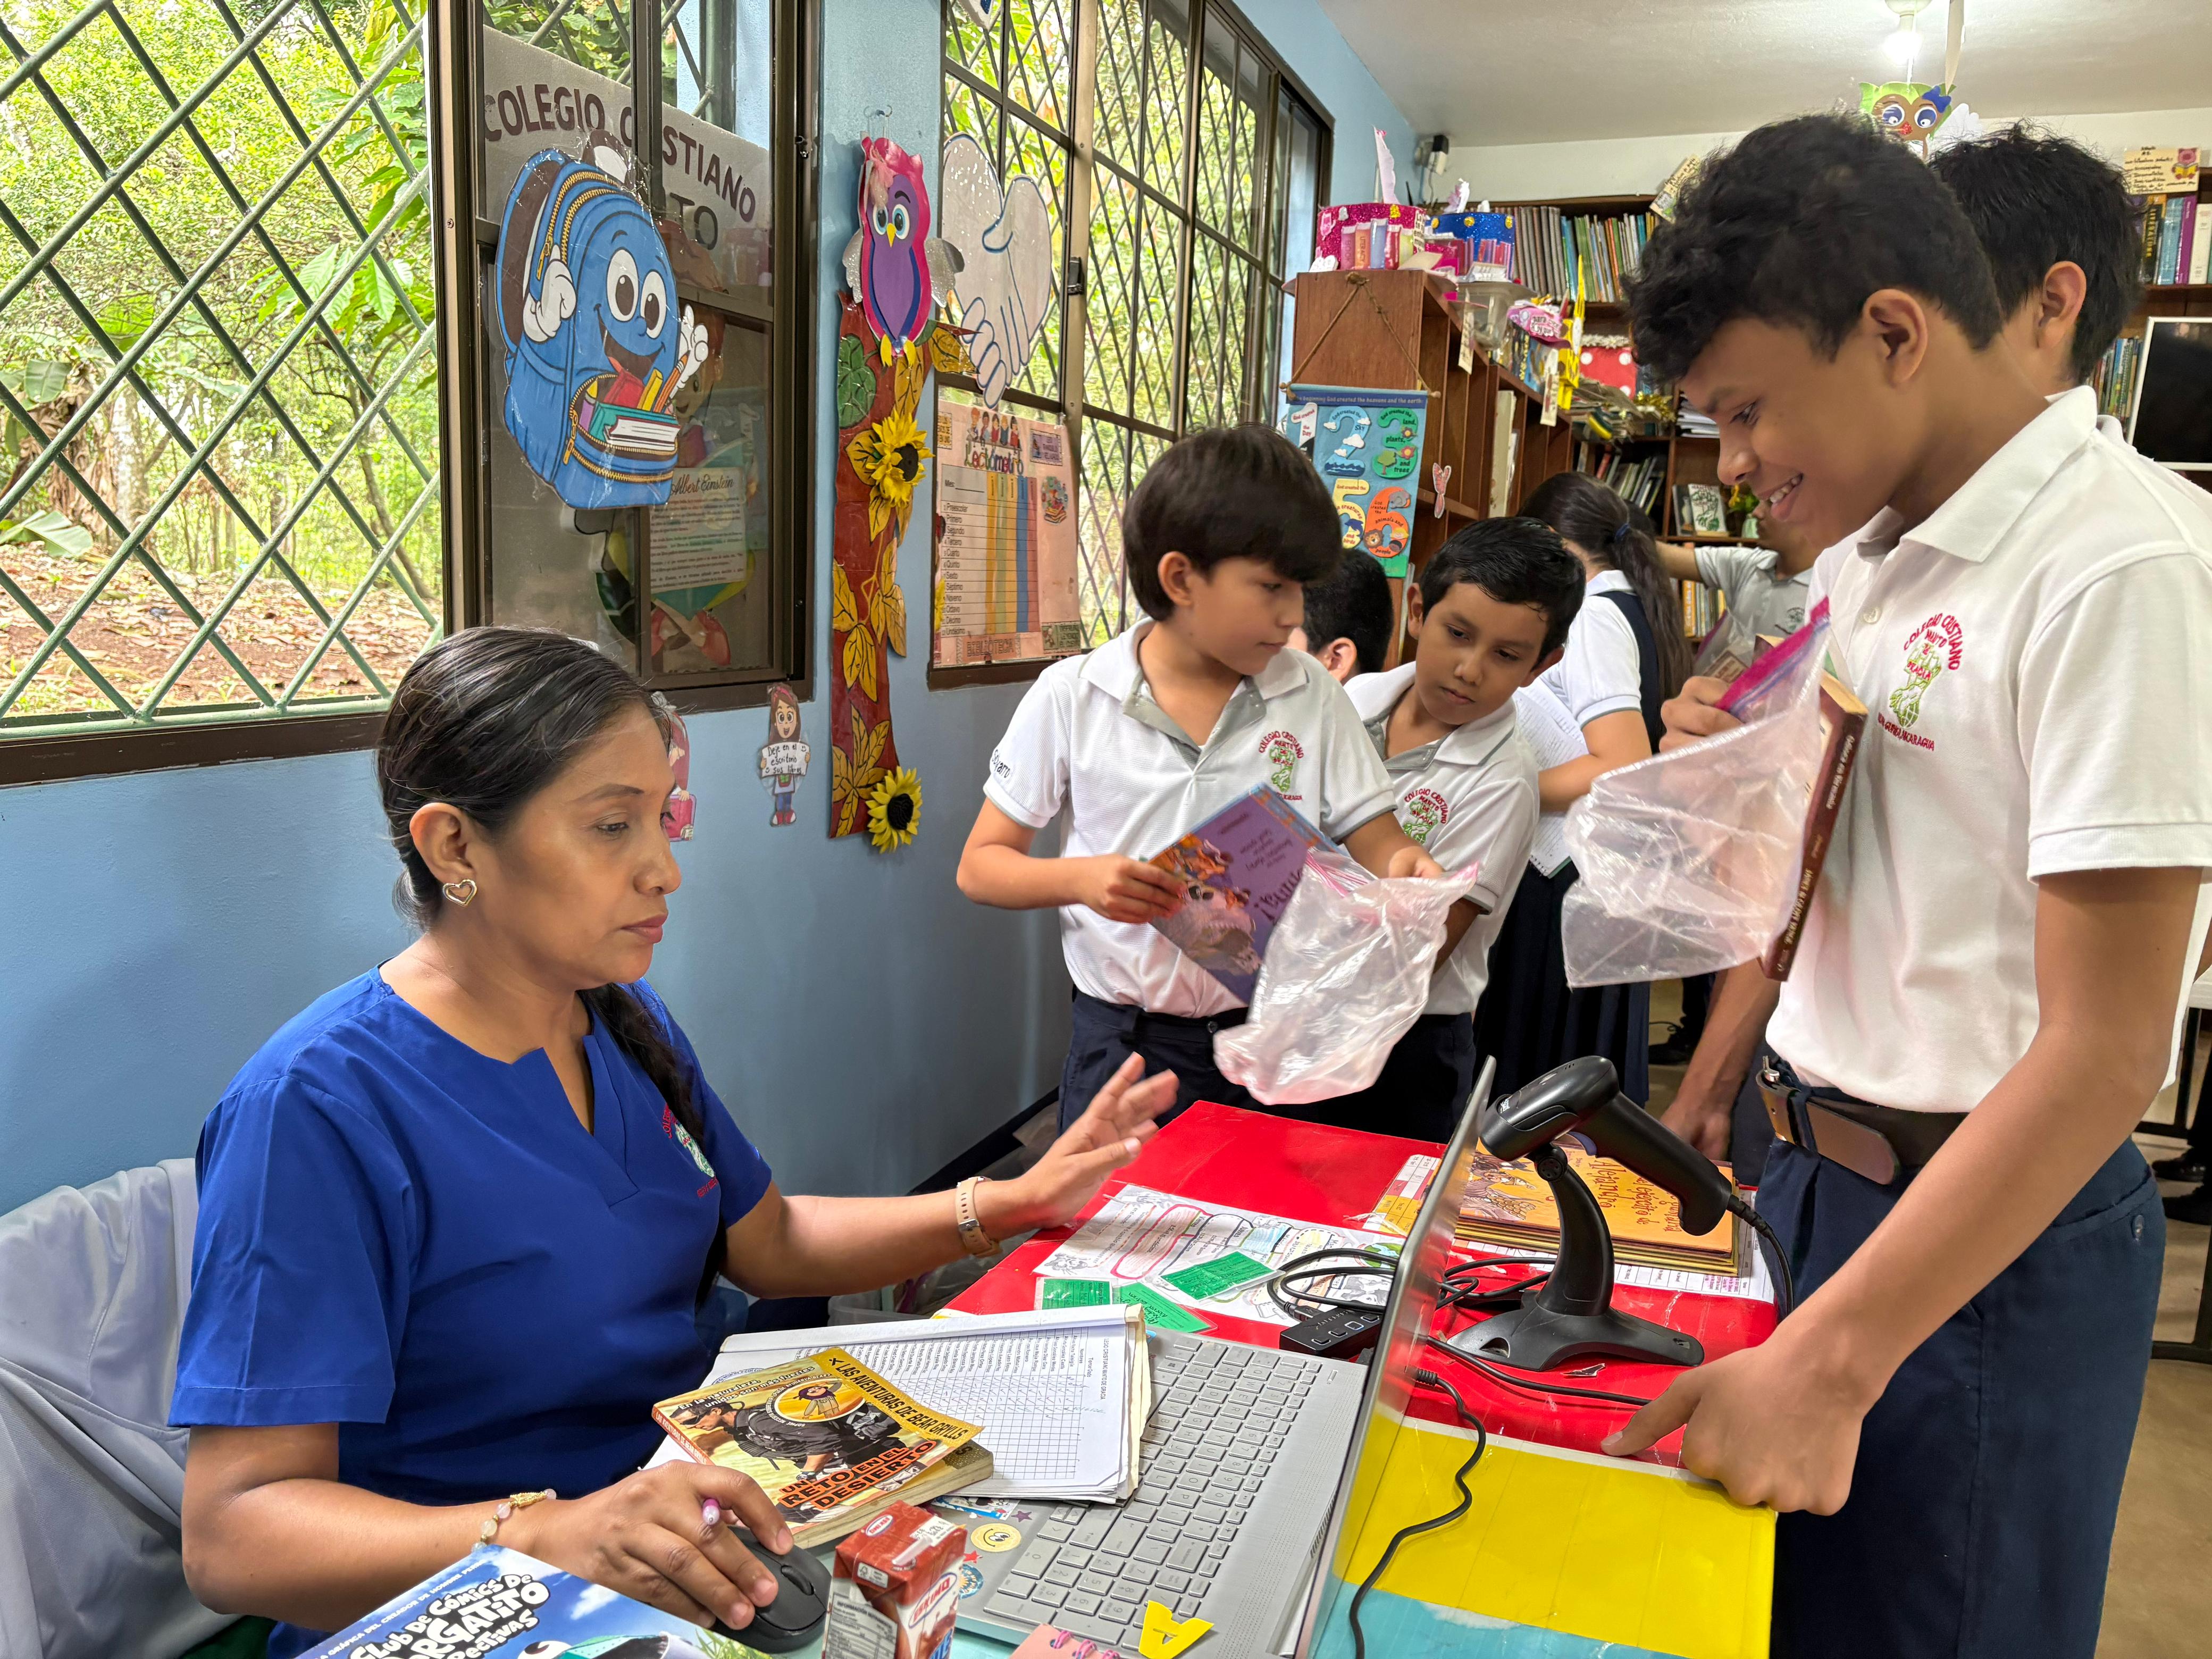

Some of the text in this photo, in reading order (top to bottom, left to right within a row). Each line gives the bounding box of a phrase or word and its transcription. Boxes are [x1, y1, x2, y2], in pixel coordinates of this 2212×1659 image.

[485, 83, 605, 142] COLEGIO
[1302, 409, 1315, 418] created
[672, 474, 734, 495] Albert Einstein
[947, 503, 968, 512] Preescolar
[948, 526, 965, 536] Segundo
[948, 537, 962, 546] Tercero
[967, 639, 1013, 657] BIBLIOTECA
[1904, 613, 1963, 671] COLEGIO CRISTIANO
[768, 745, 781, 758] Deje
[1259, 731, 1280, 753] COLEGIO
[771, 755, 797, 766] escritorio
[1404, 789, 1430, 802] COLEGIO
[1587, 1160, 1635, 1209] Alejandro
[705, 1366, 815, 1407] unidos son más fuertes
[706, 1379, 761, 1400] naturaleza,
[835, 1363, 969, 1440] LAS AVENTURAS DE BEAR GRYLLS
[782, 1448, 907, 1506] RETO EN EL
[814, 1442, 934, 1506] DESIERTO
[781, 1480, 809, 1493] UN
[869, 1516, 890, 1535] ESKIMO
[364, 1623, 382, 1634] DEL
[381, 1601, 419, 1623] CREADOR
[430, 1574, 463, 1594] HOMBRE
[912, 1578, 951, 1621] ESKIMO
